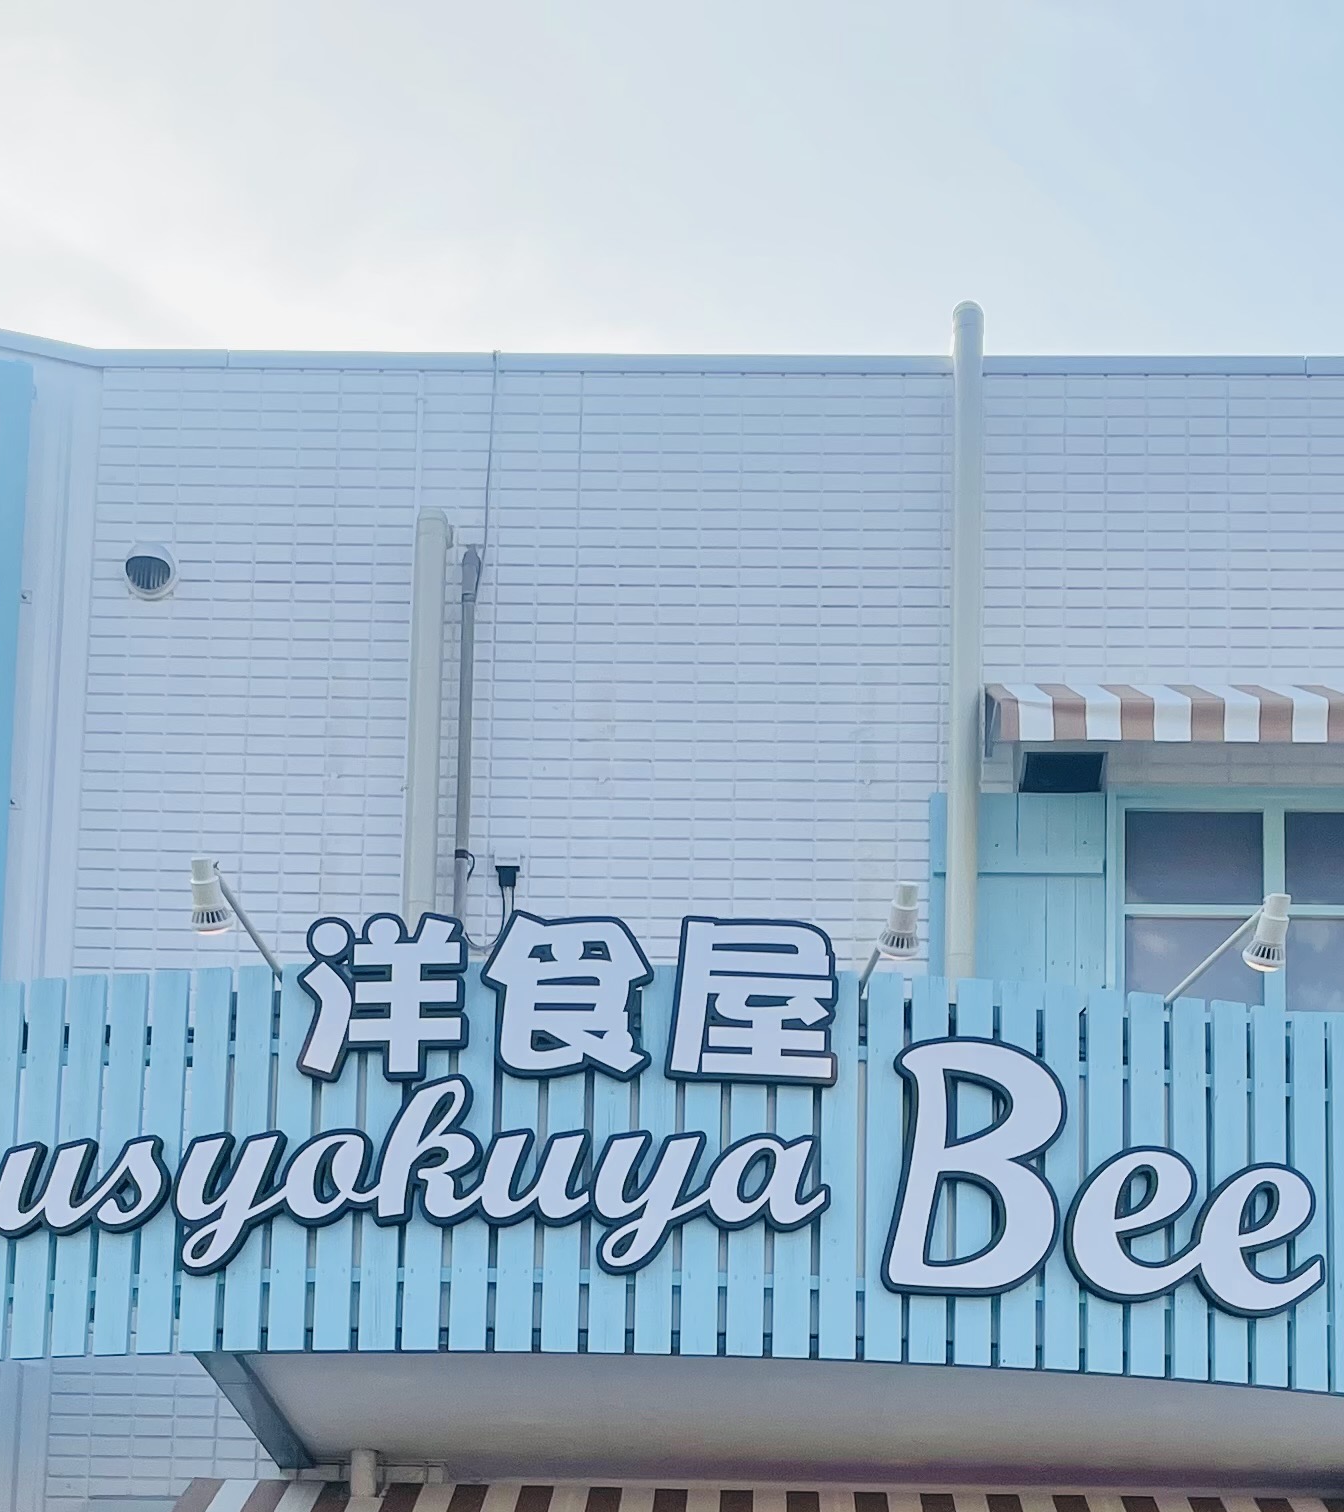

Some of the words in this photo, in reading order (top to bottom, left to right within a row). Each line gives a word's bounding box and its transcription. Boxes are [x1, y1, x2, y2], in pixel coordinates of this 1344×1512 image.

[296, 911, 839, 1087] 洋食屋
[879, 1035, 1329, 1316] Bee
